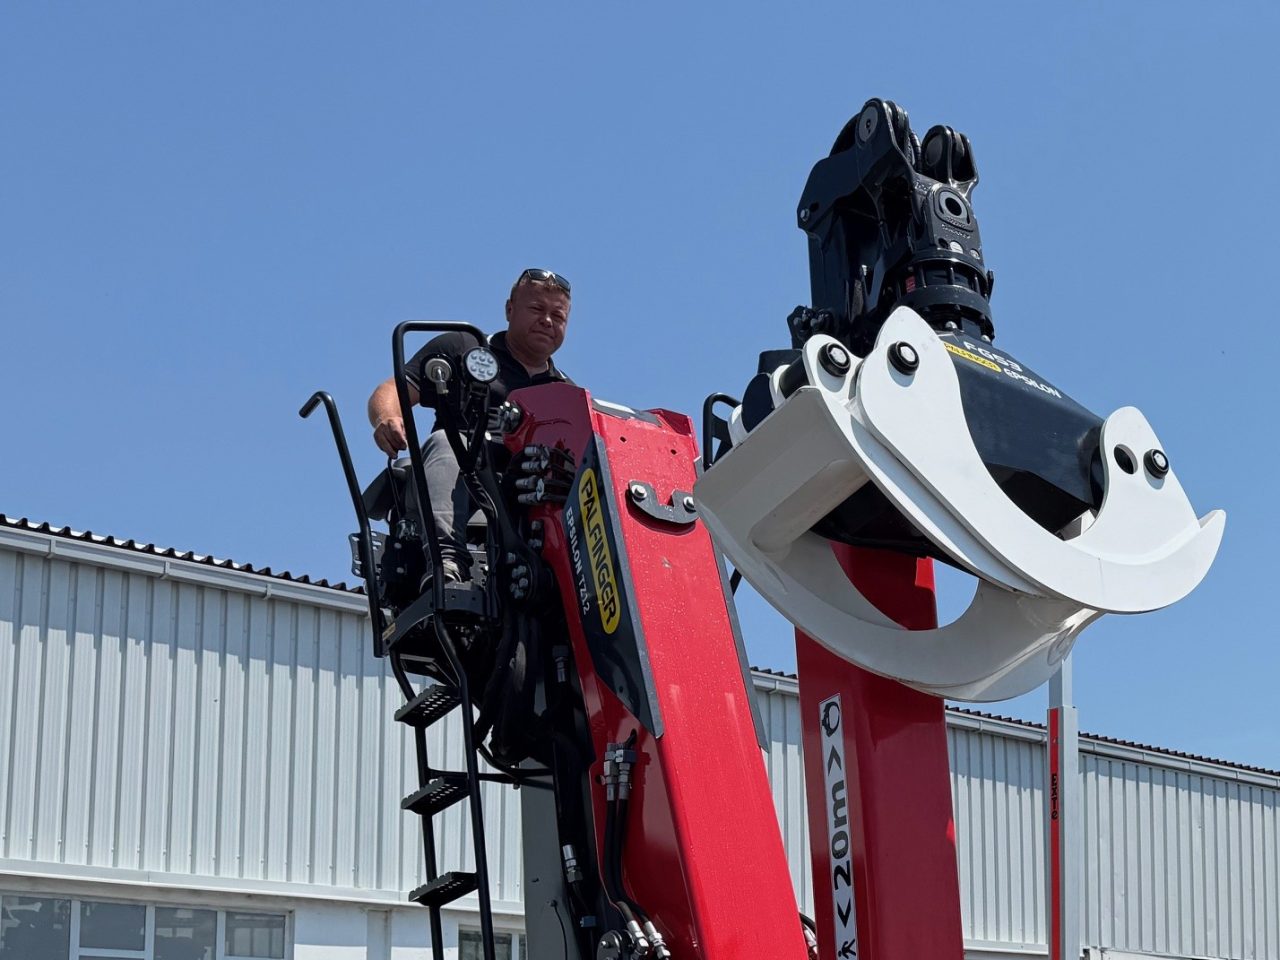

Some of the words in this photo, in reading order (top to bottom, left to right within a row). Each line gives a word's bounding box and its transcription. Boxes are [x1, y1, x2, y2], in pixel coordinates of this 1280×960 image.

[963, 341, 1023, 372] FG53
[1003, 368, 1062, 398] EPSILON
[566, 506, 583, 575] EPSILON
[581, 475, 617, 625] PALFINGER
